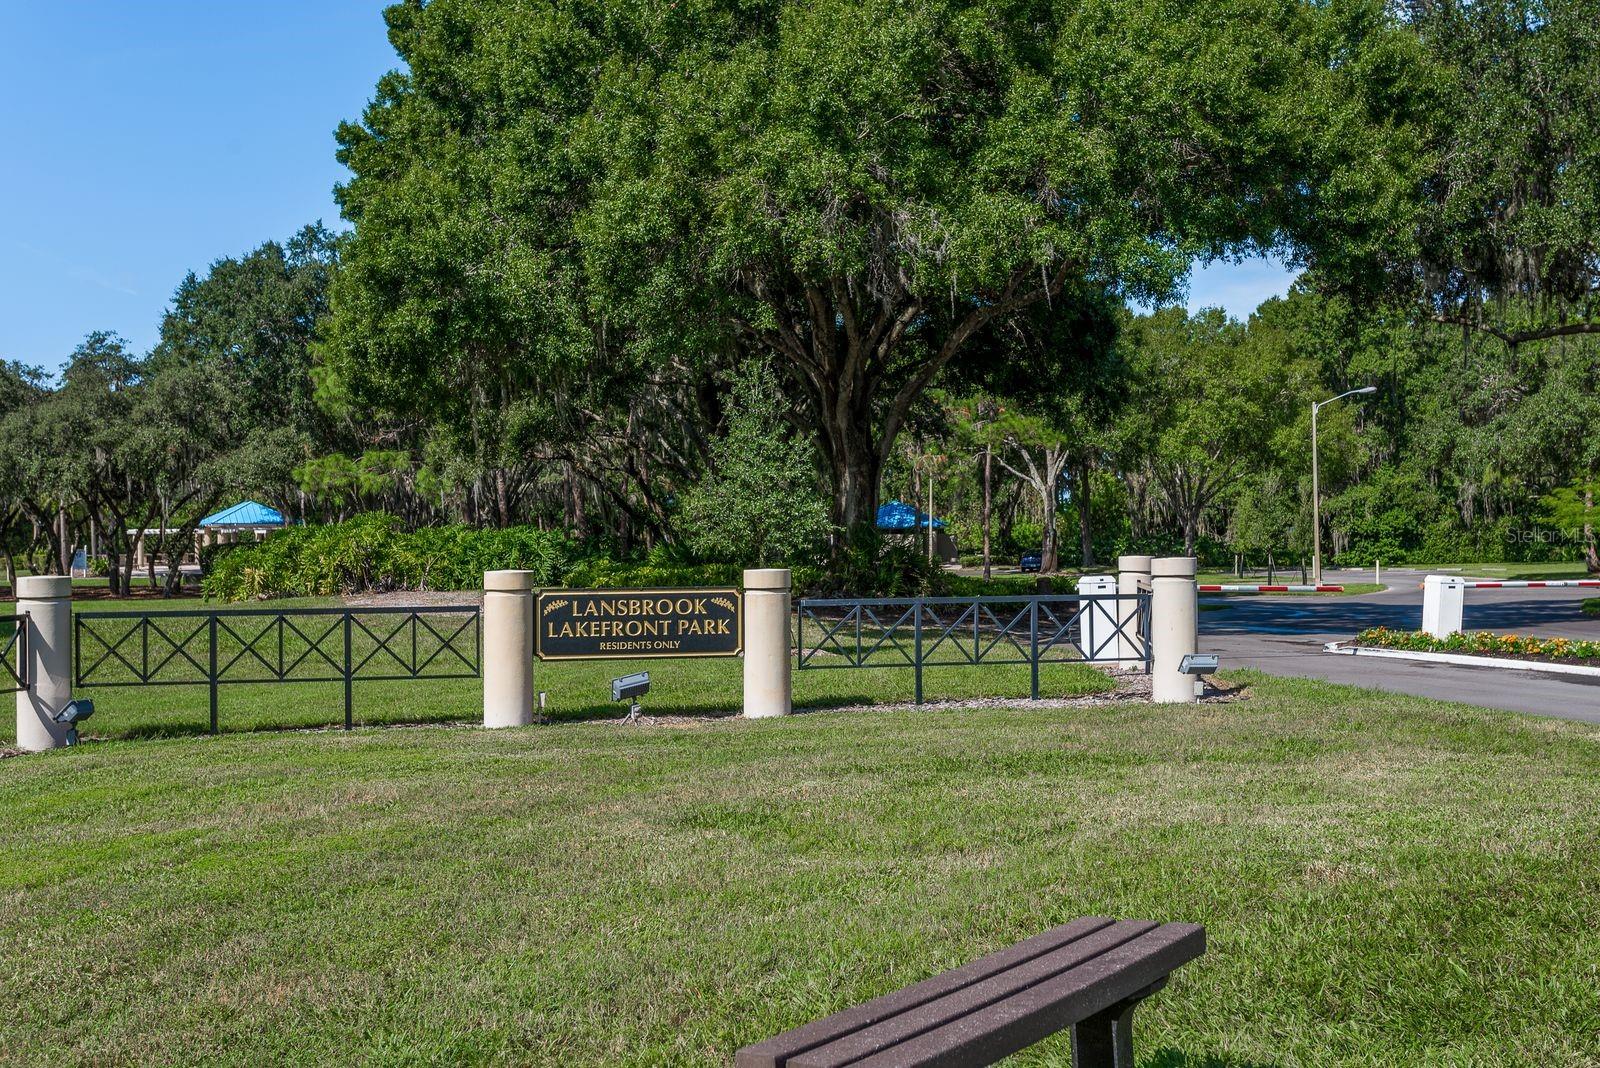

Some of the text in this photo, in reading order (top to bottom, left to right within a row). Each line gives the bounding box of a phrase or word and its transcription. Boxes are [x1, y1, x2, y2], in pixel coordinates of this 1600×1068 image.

[572, 598, 707, 617] LANSBROOK
[548, 618, 730, 638] LAKEFRONT PARK
[600, 640, 680, 650] RESIDENTS ONLY
